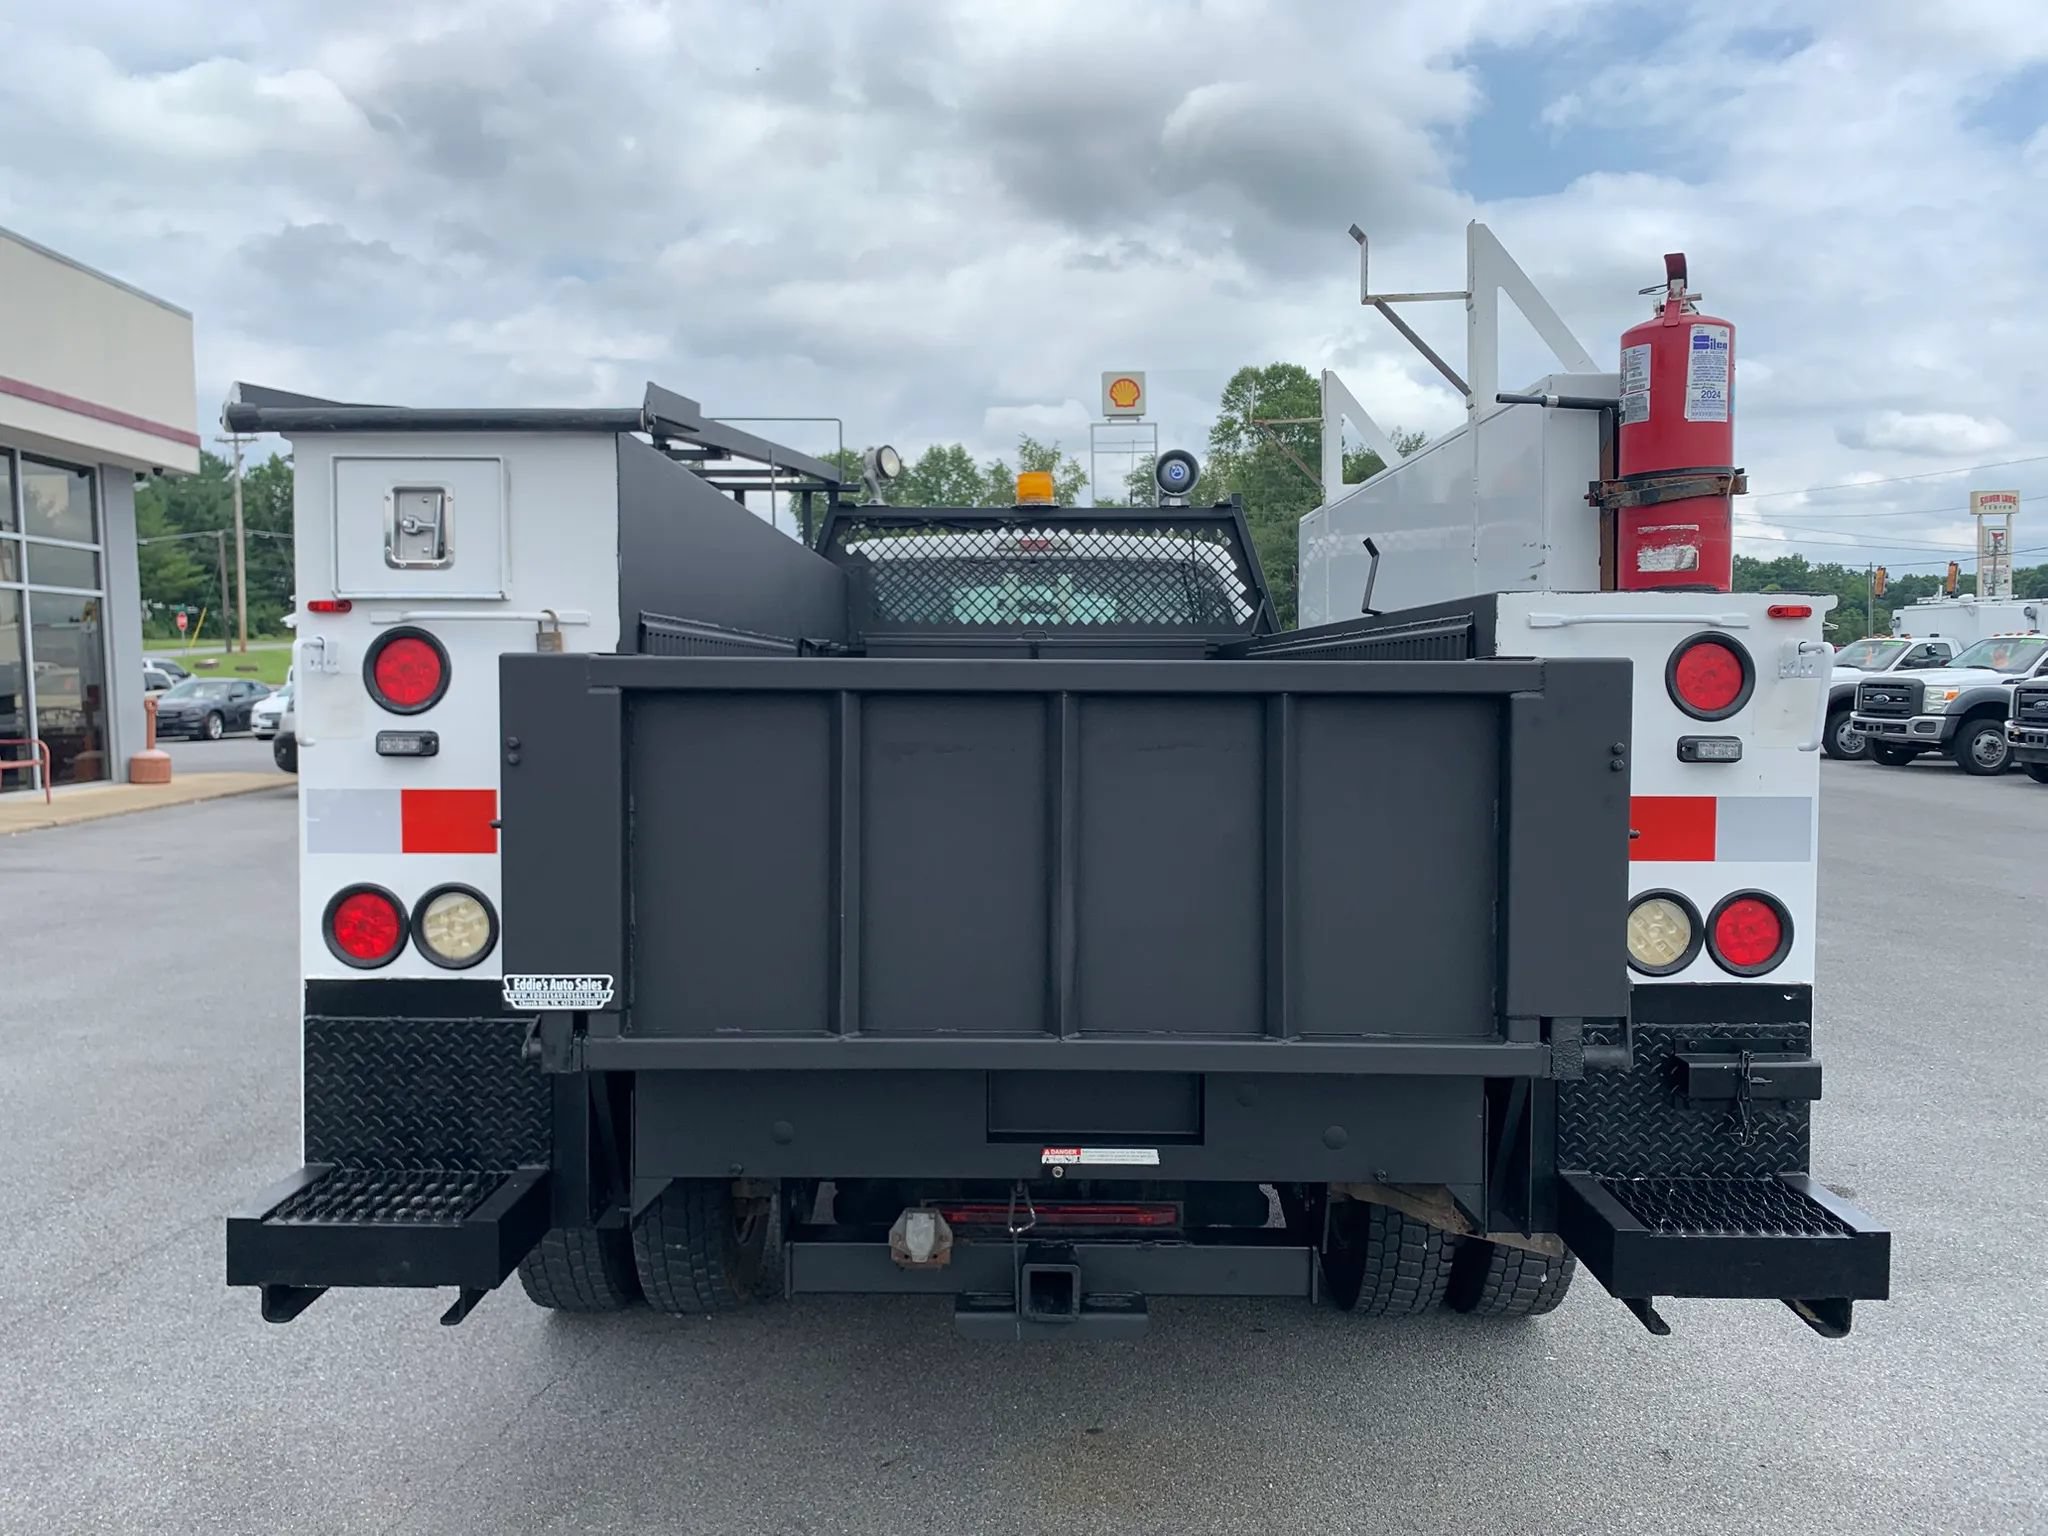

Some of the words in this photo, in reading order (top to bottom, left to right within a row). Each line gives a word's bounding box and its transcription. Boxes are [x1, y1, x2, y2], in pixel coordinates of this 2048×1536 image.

[1693, 335, 1727, 350] Silco
[1701, 390, 1721, 399] 2024
[513, 978, 548, 990] Eddie's
[550, 978, 574, 990] Auto
[575, 977, 602, 990] Sales
